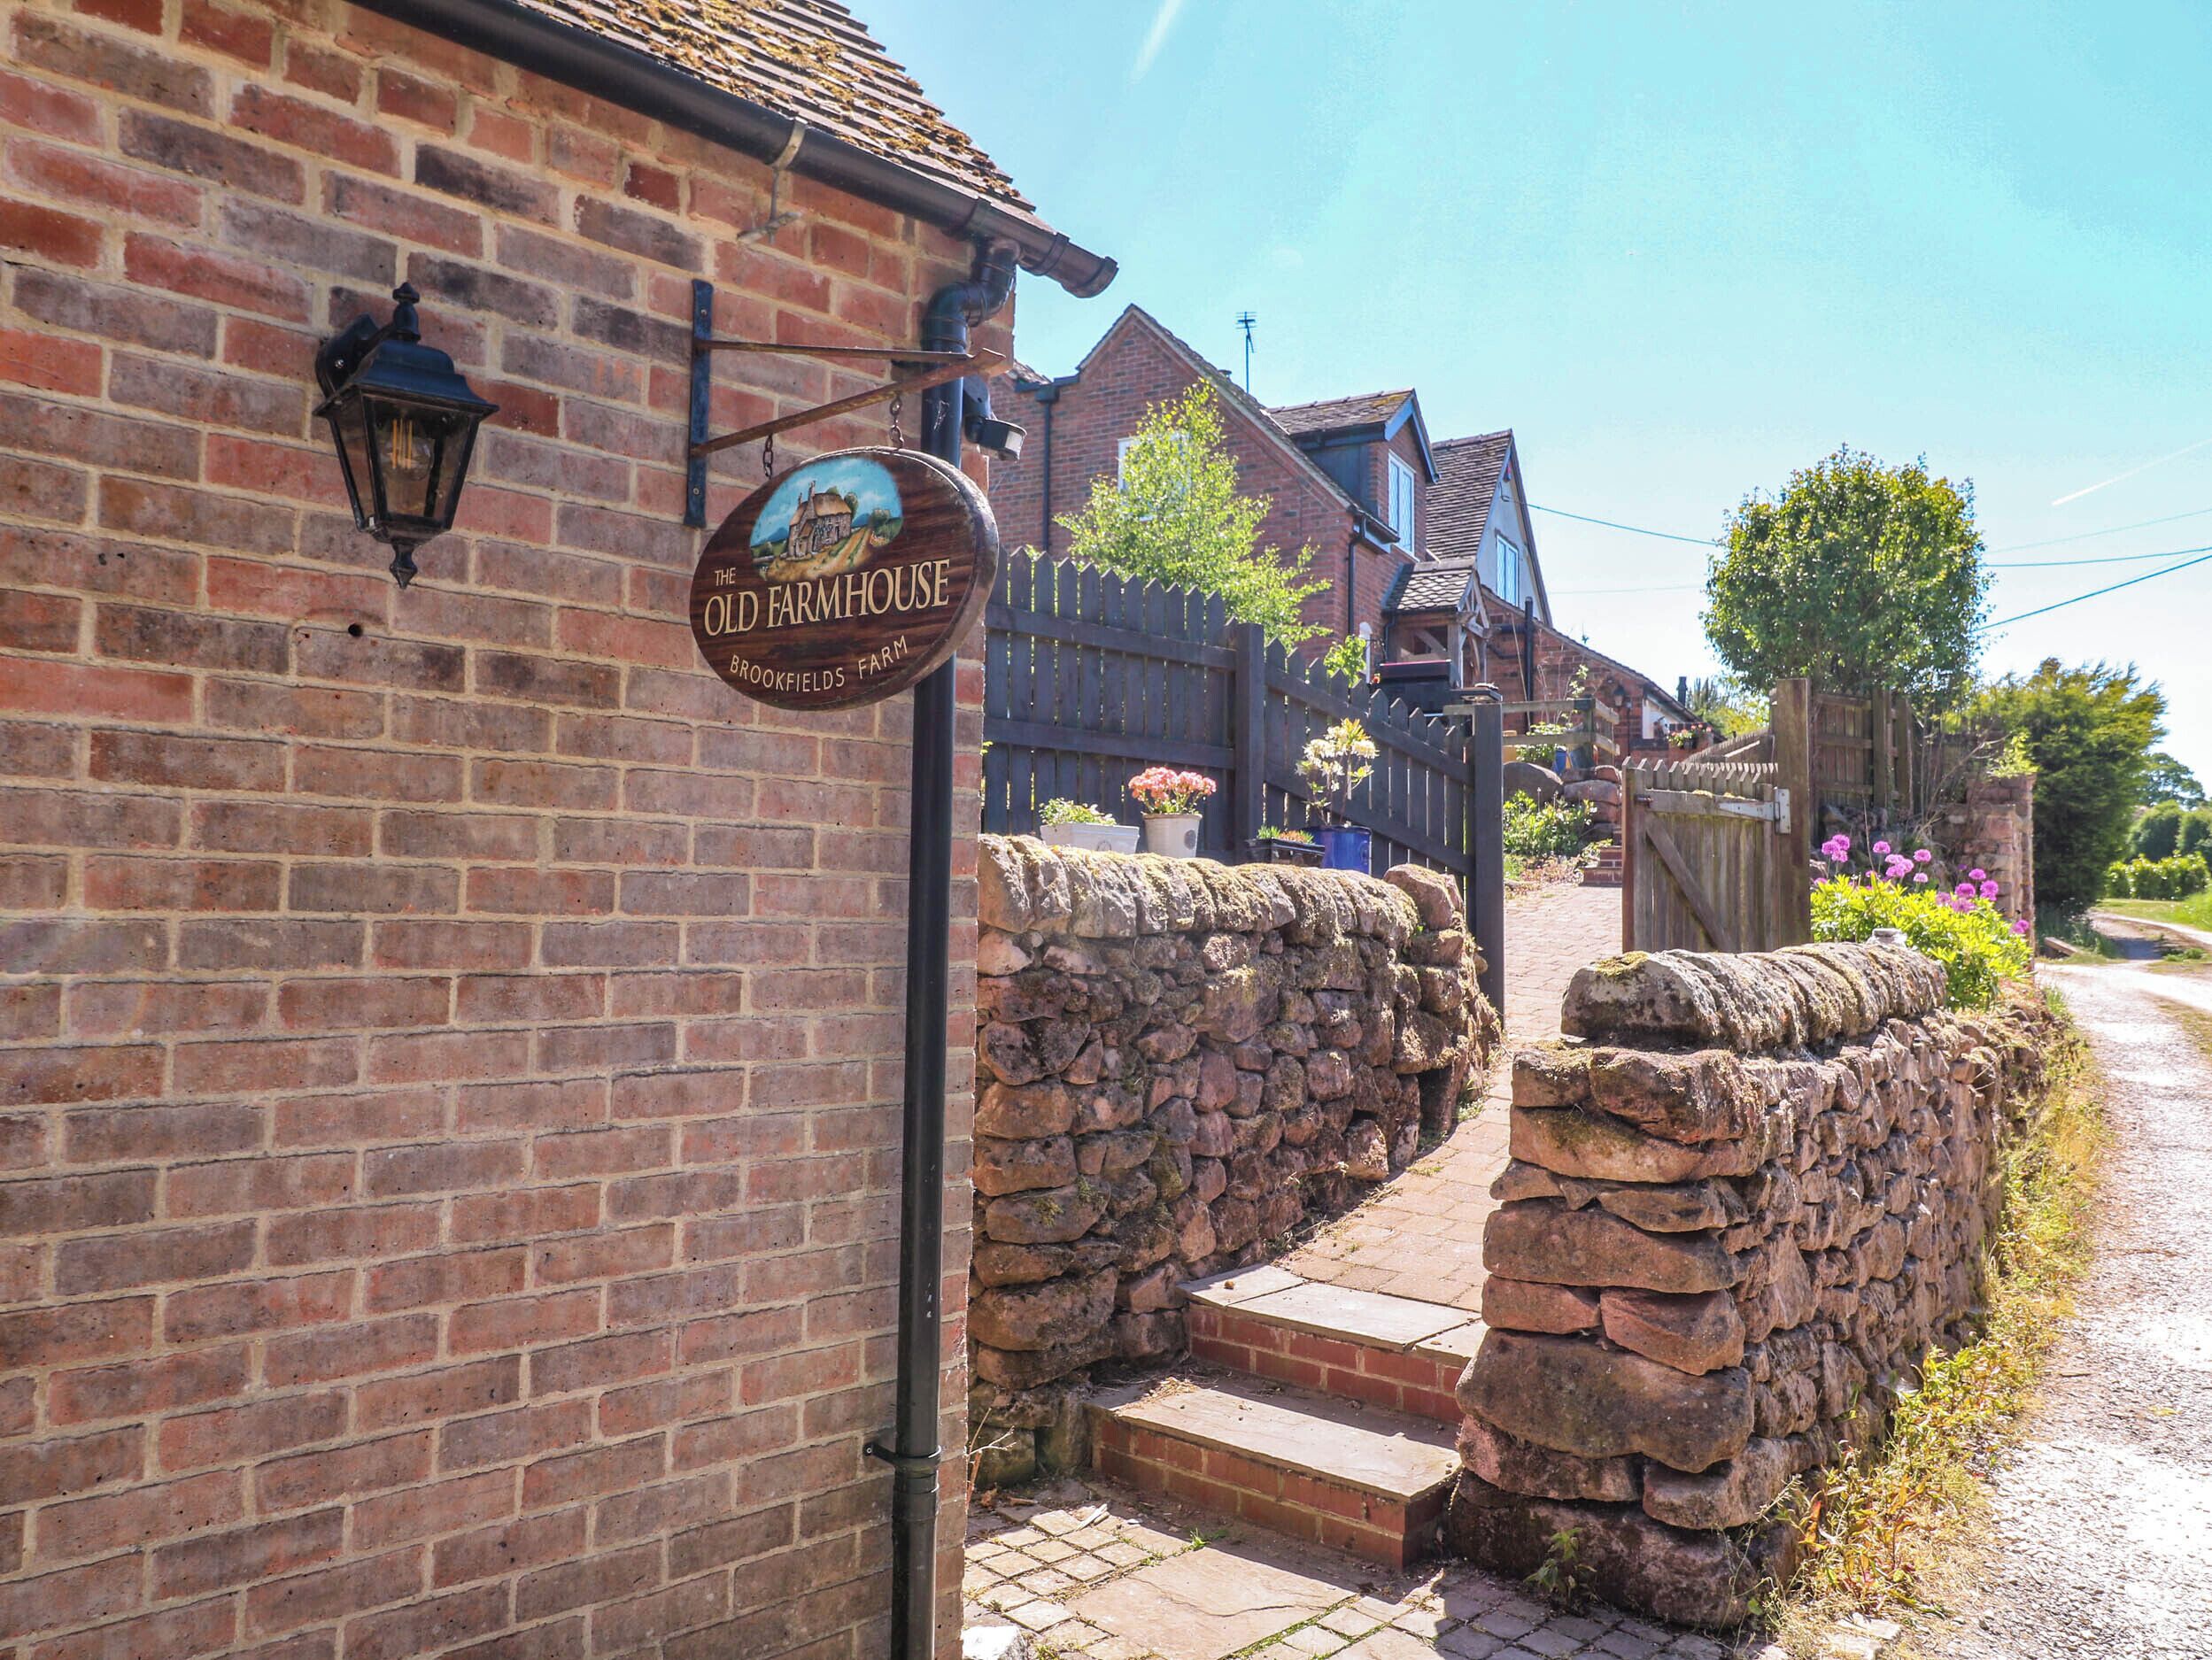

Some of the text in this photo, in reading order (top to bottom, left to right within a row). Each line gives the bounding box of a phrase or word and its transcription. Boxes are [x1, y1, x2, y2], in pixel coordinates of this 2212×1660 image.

[704, 559, 950, 637] OLD FARMHOUSE
[715, 567, 736, 587] THE
[730, 635, 909, 693] BROOKFIELDS FARM
